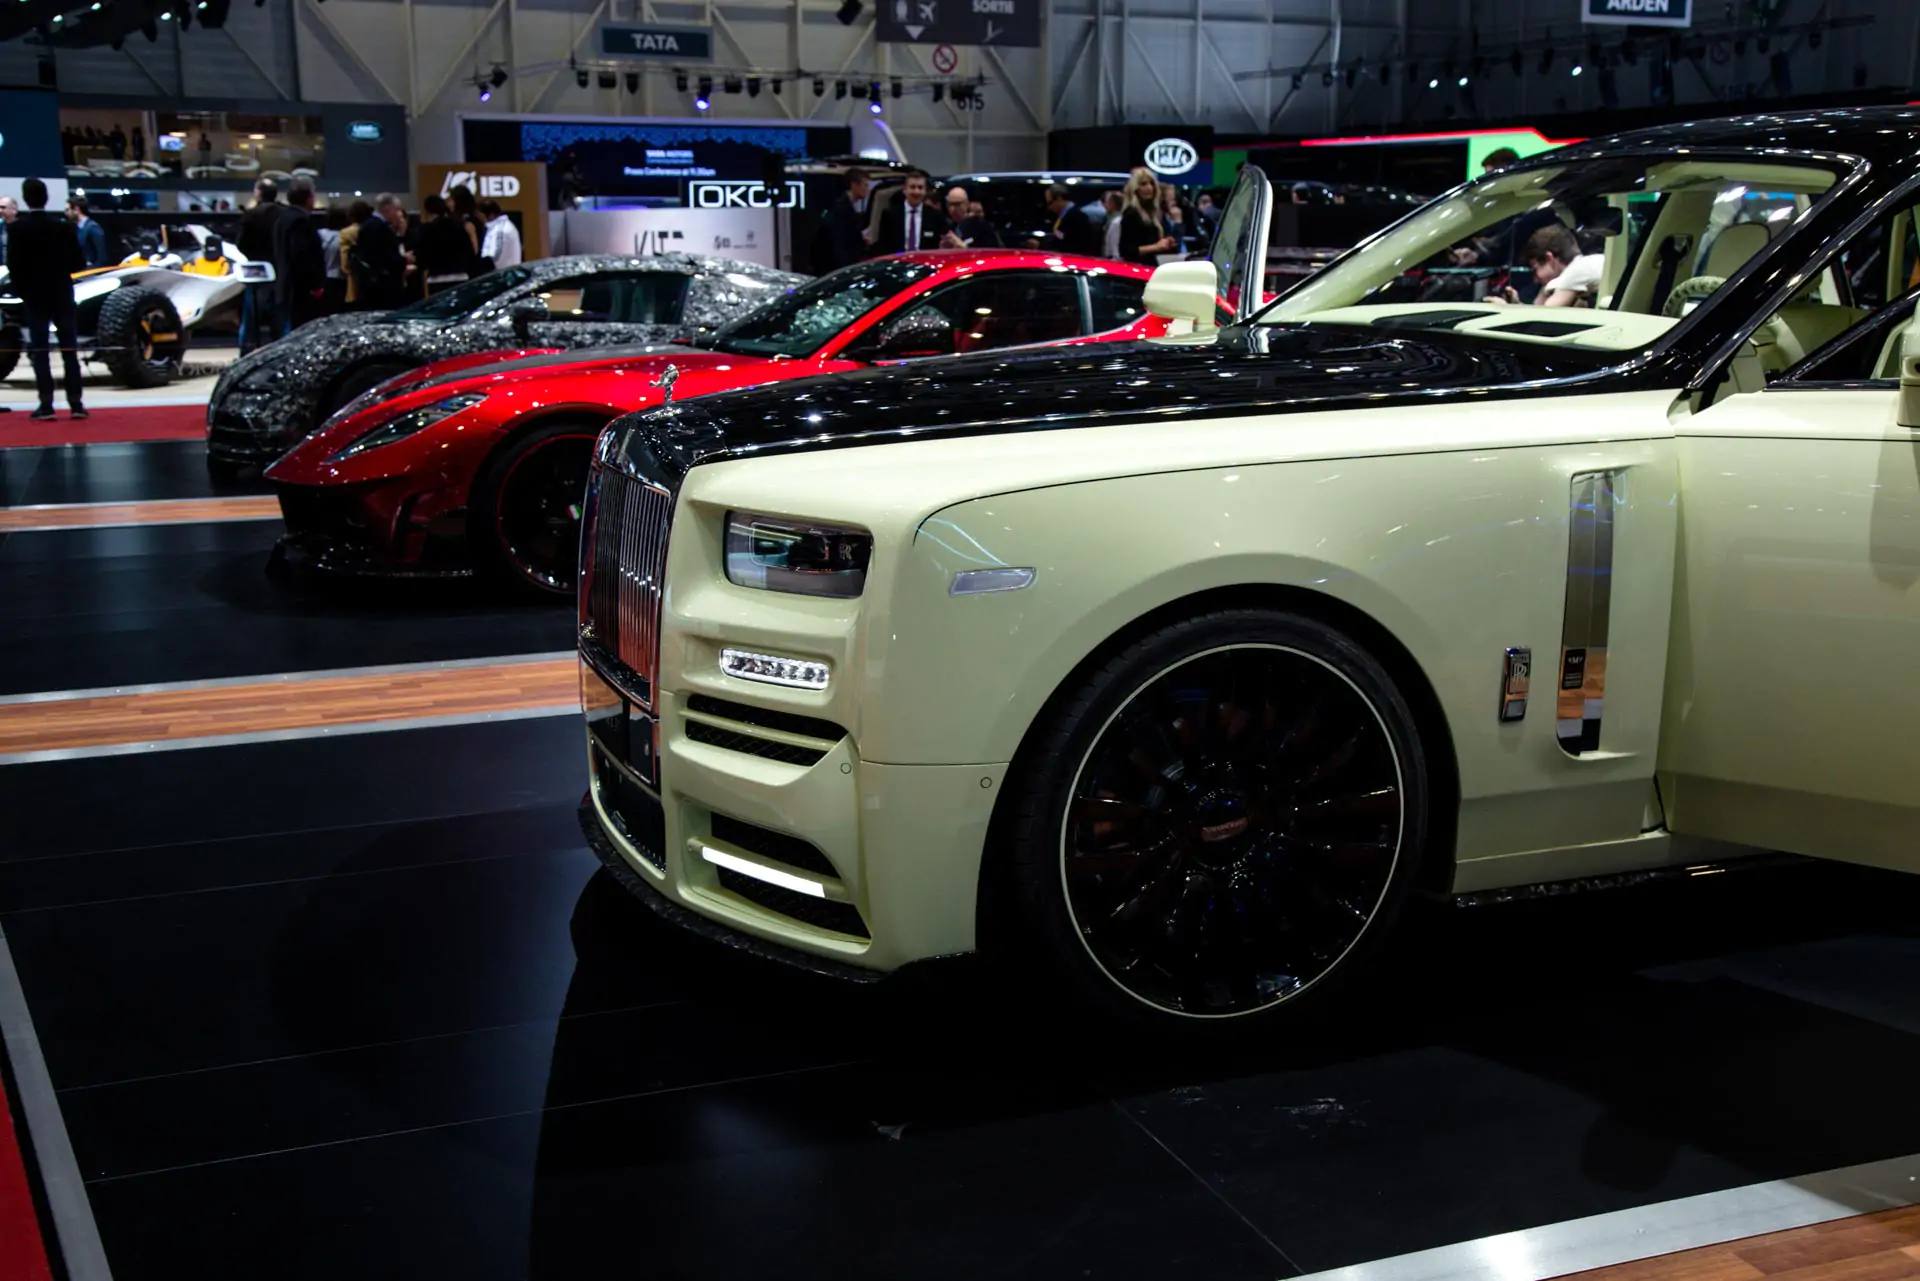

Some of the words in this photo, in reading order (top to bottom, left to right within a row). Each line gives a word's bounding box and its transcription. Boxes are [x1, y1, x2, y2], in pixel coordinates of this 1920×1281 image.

[972, 0, 1015, 14] SORTIE
[1606, 0, 1669, 12] ARDEN
[630, 33, 681, 52] TATA
[480, 175, 521, 197] IED
